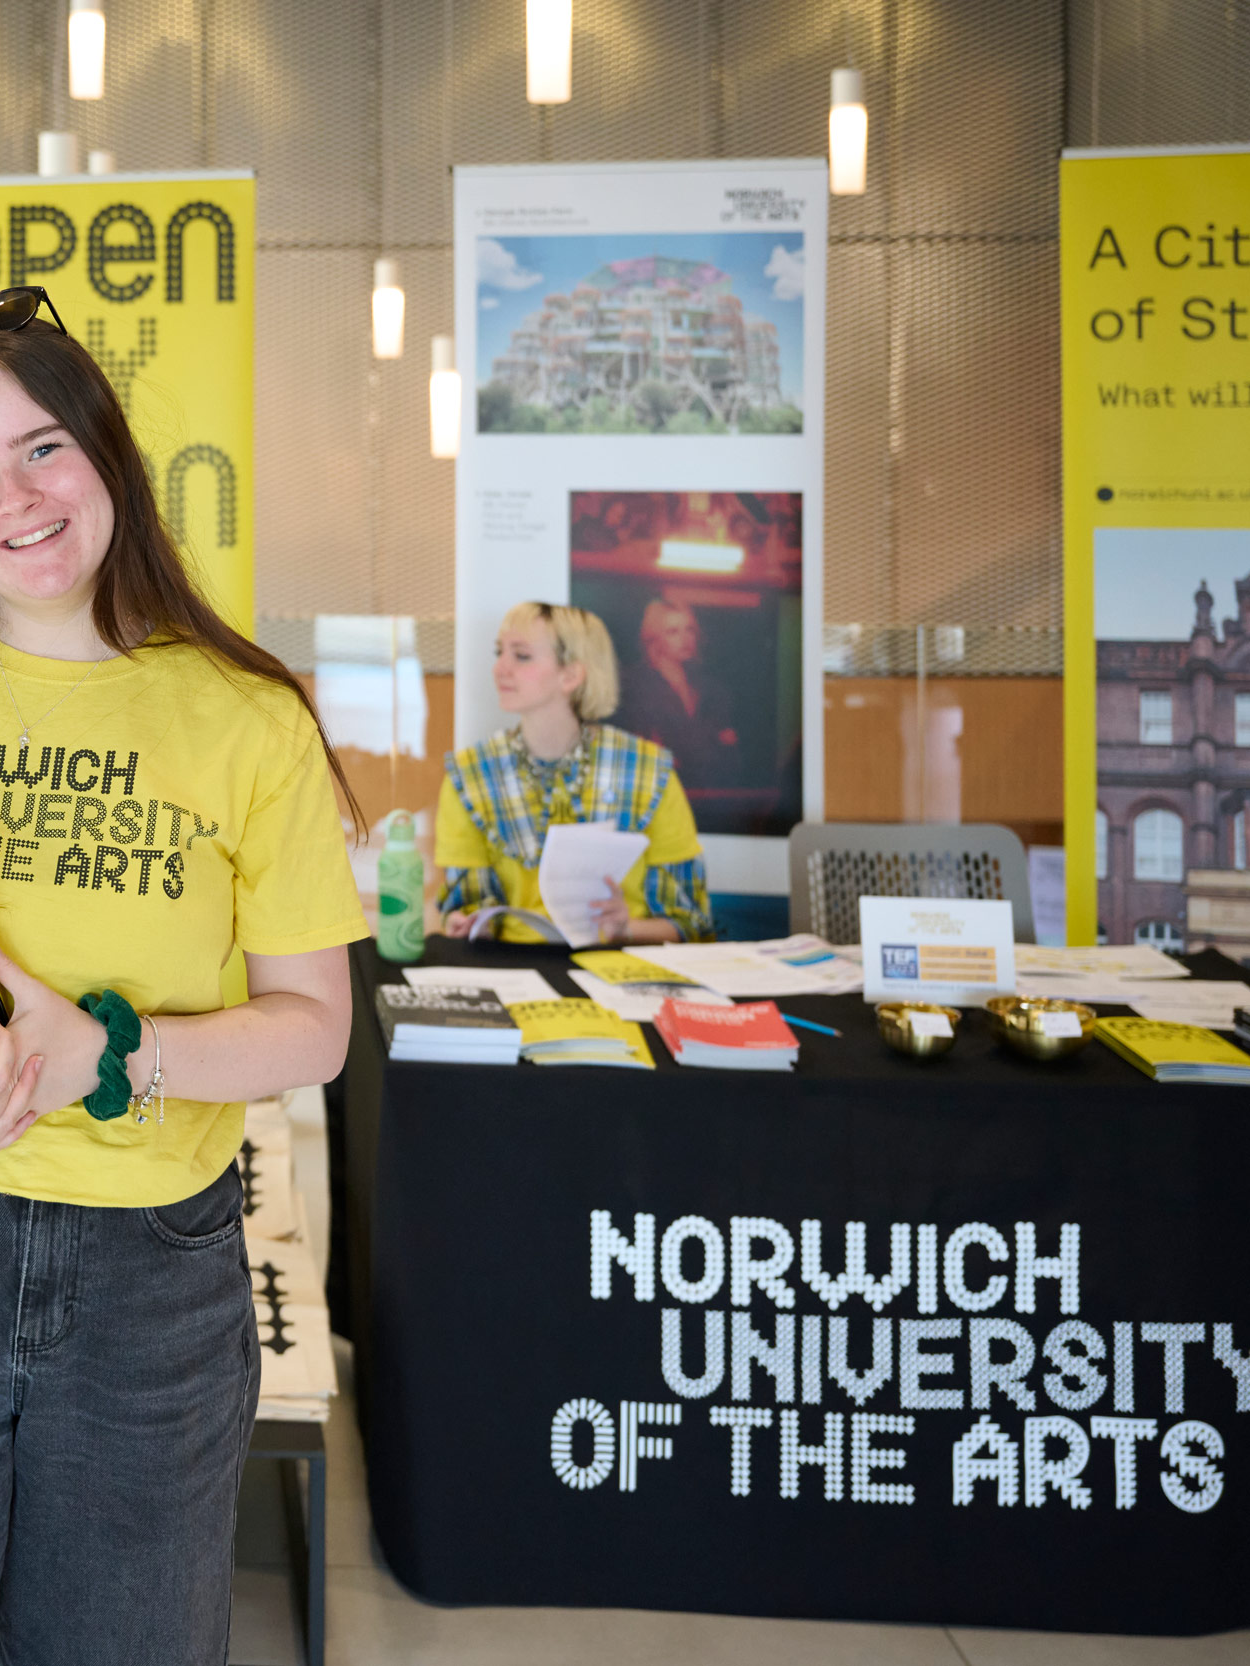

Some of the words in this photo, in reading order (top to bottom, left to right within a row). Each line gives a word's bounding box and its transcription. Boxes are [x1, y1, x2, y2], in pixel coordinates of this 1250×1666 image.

[1089, 226, 1127, 271] A
[1154, 222, 1250, 269] Cit
[1090, 297, 1154, 342] of
[1182, 296, 1249, 341] St
[1098, 382, 1175, 408] What
[1189, 382, 1250, 408] will
[54, 843, 185, 899] ARTS
[590, 1209, 1080, 1314] NORWICH
[660, 1307, 1250, 1414] UNIVERSITY
[551, 1397, 682, 1492] OF
[709, 1405, 915, 1506] THE
[952, 1414, 1225, 1514] ARTS
